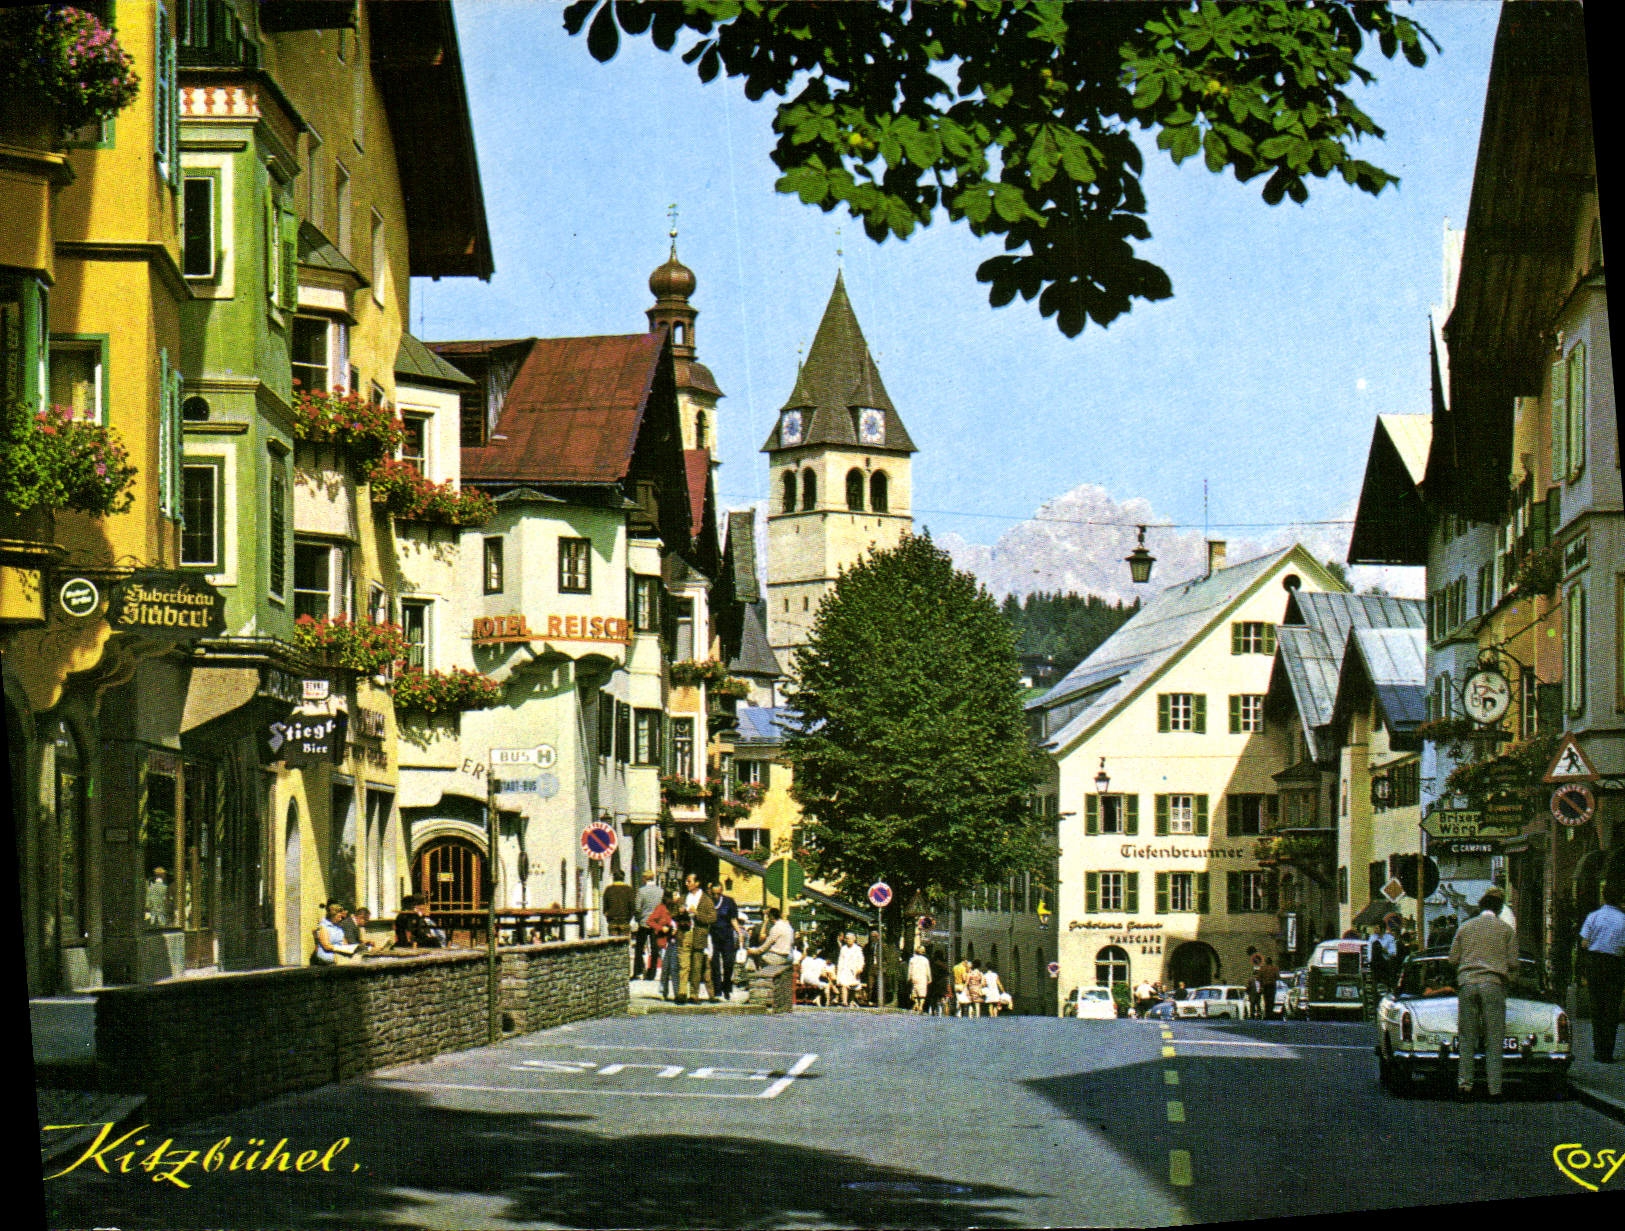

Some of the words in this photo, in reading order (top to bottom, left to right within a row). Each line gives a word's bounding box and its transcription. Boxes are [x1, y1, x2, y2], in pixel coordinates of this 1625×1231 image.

[303, 742, 328, 753] Bier
[500, 751, 530, 762] BUS
[537, 749, 552, 763] H
[1120, 843, 1243, 859] Tiefenbrunner
[1141, 945, 1162, 954] BAR
